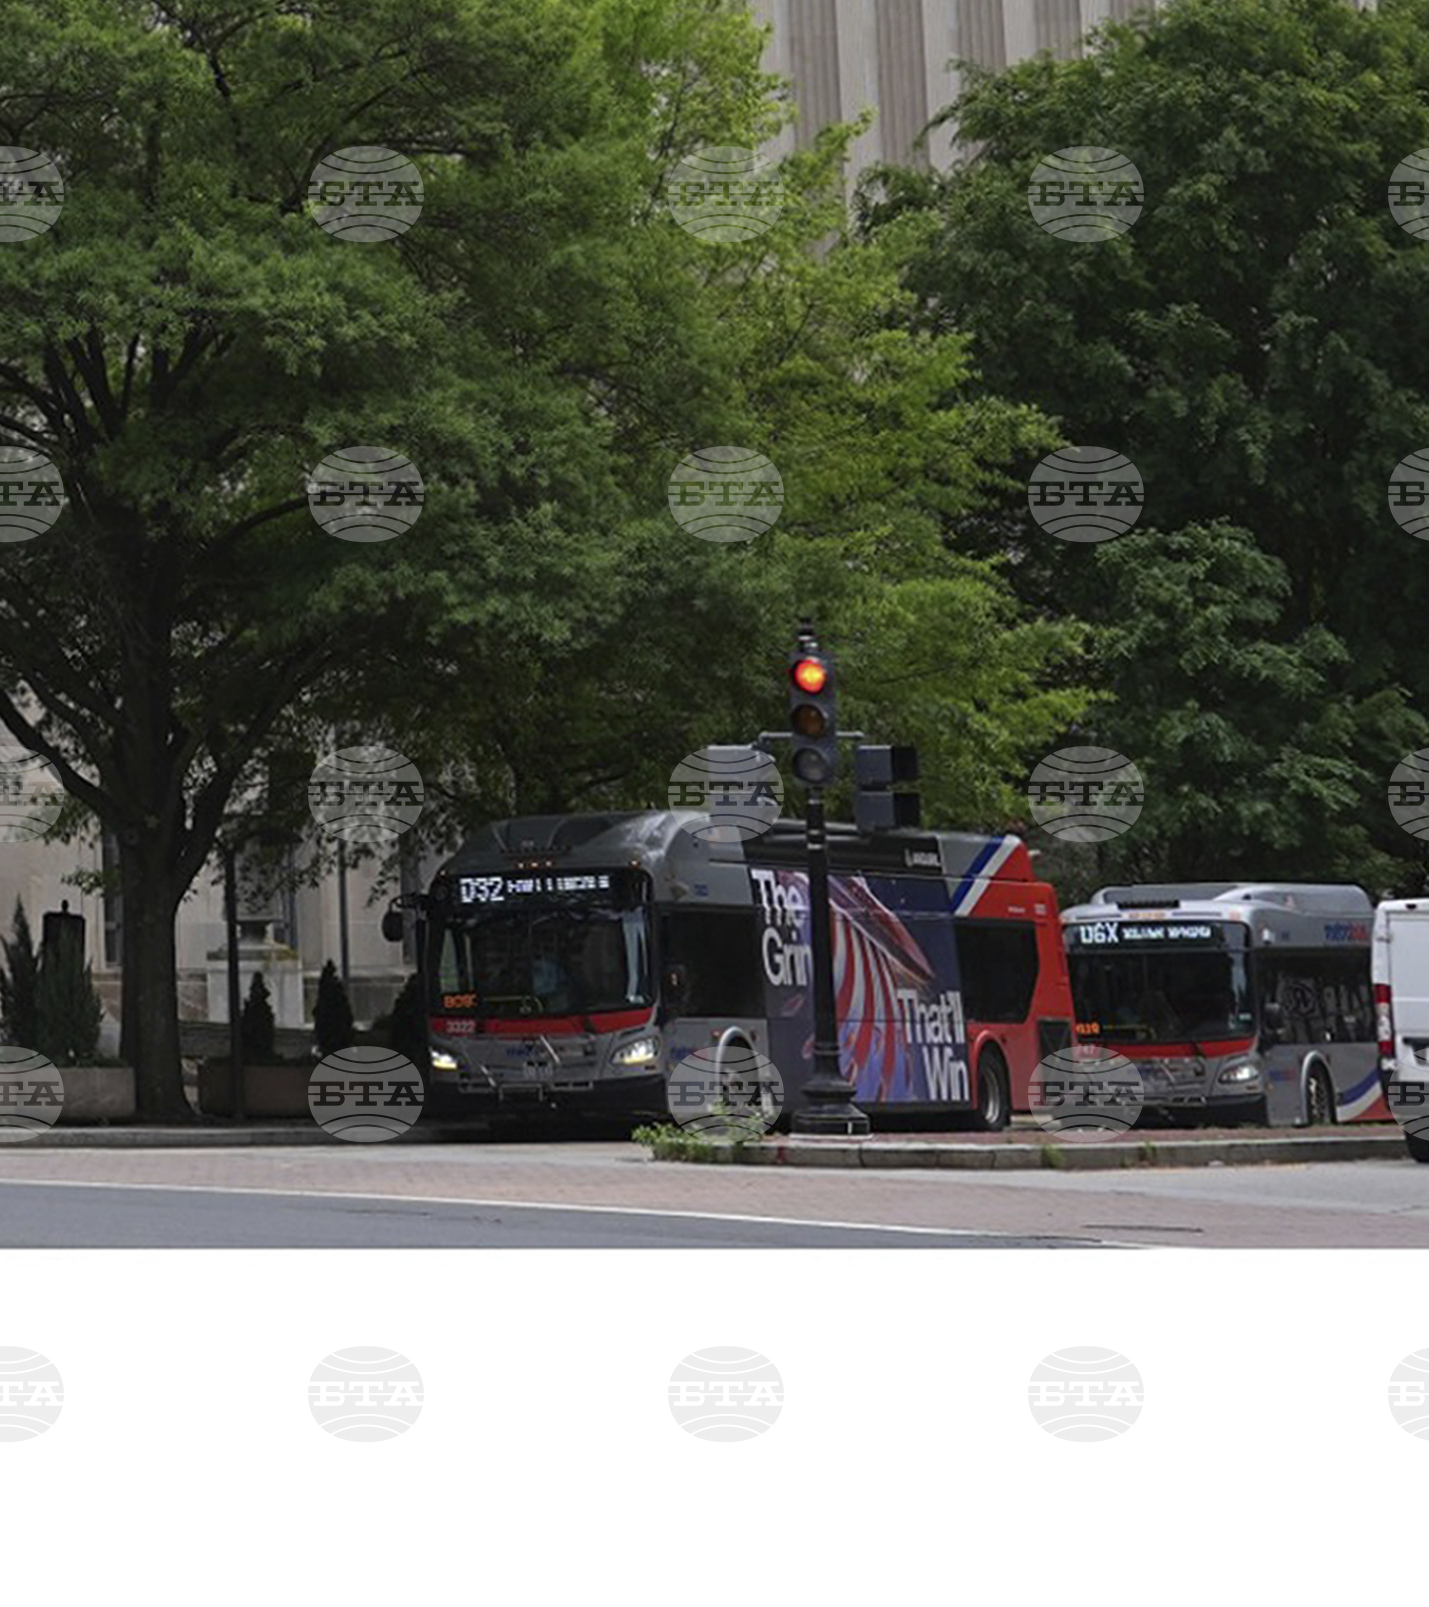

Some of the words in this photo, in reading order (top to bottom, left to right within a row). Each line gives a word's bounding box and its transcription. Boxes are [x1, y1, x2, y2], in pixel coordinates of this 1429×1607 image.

[460, 876, 505, 903] D32
[749, 867, 811, 926] The
[761, 927, 814, 987] Grin
[897, 988, 966, 1045] That'll
[922, 1045, 971, 1102] Win
